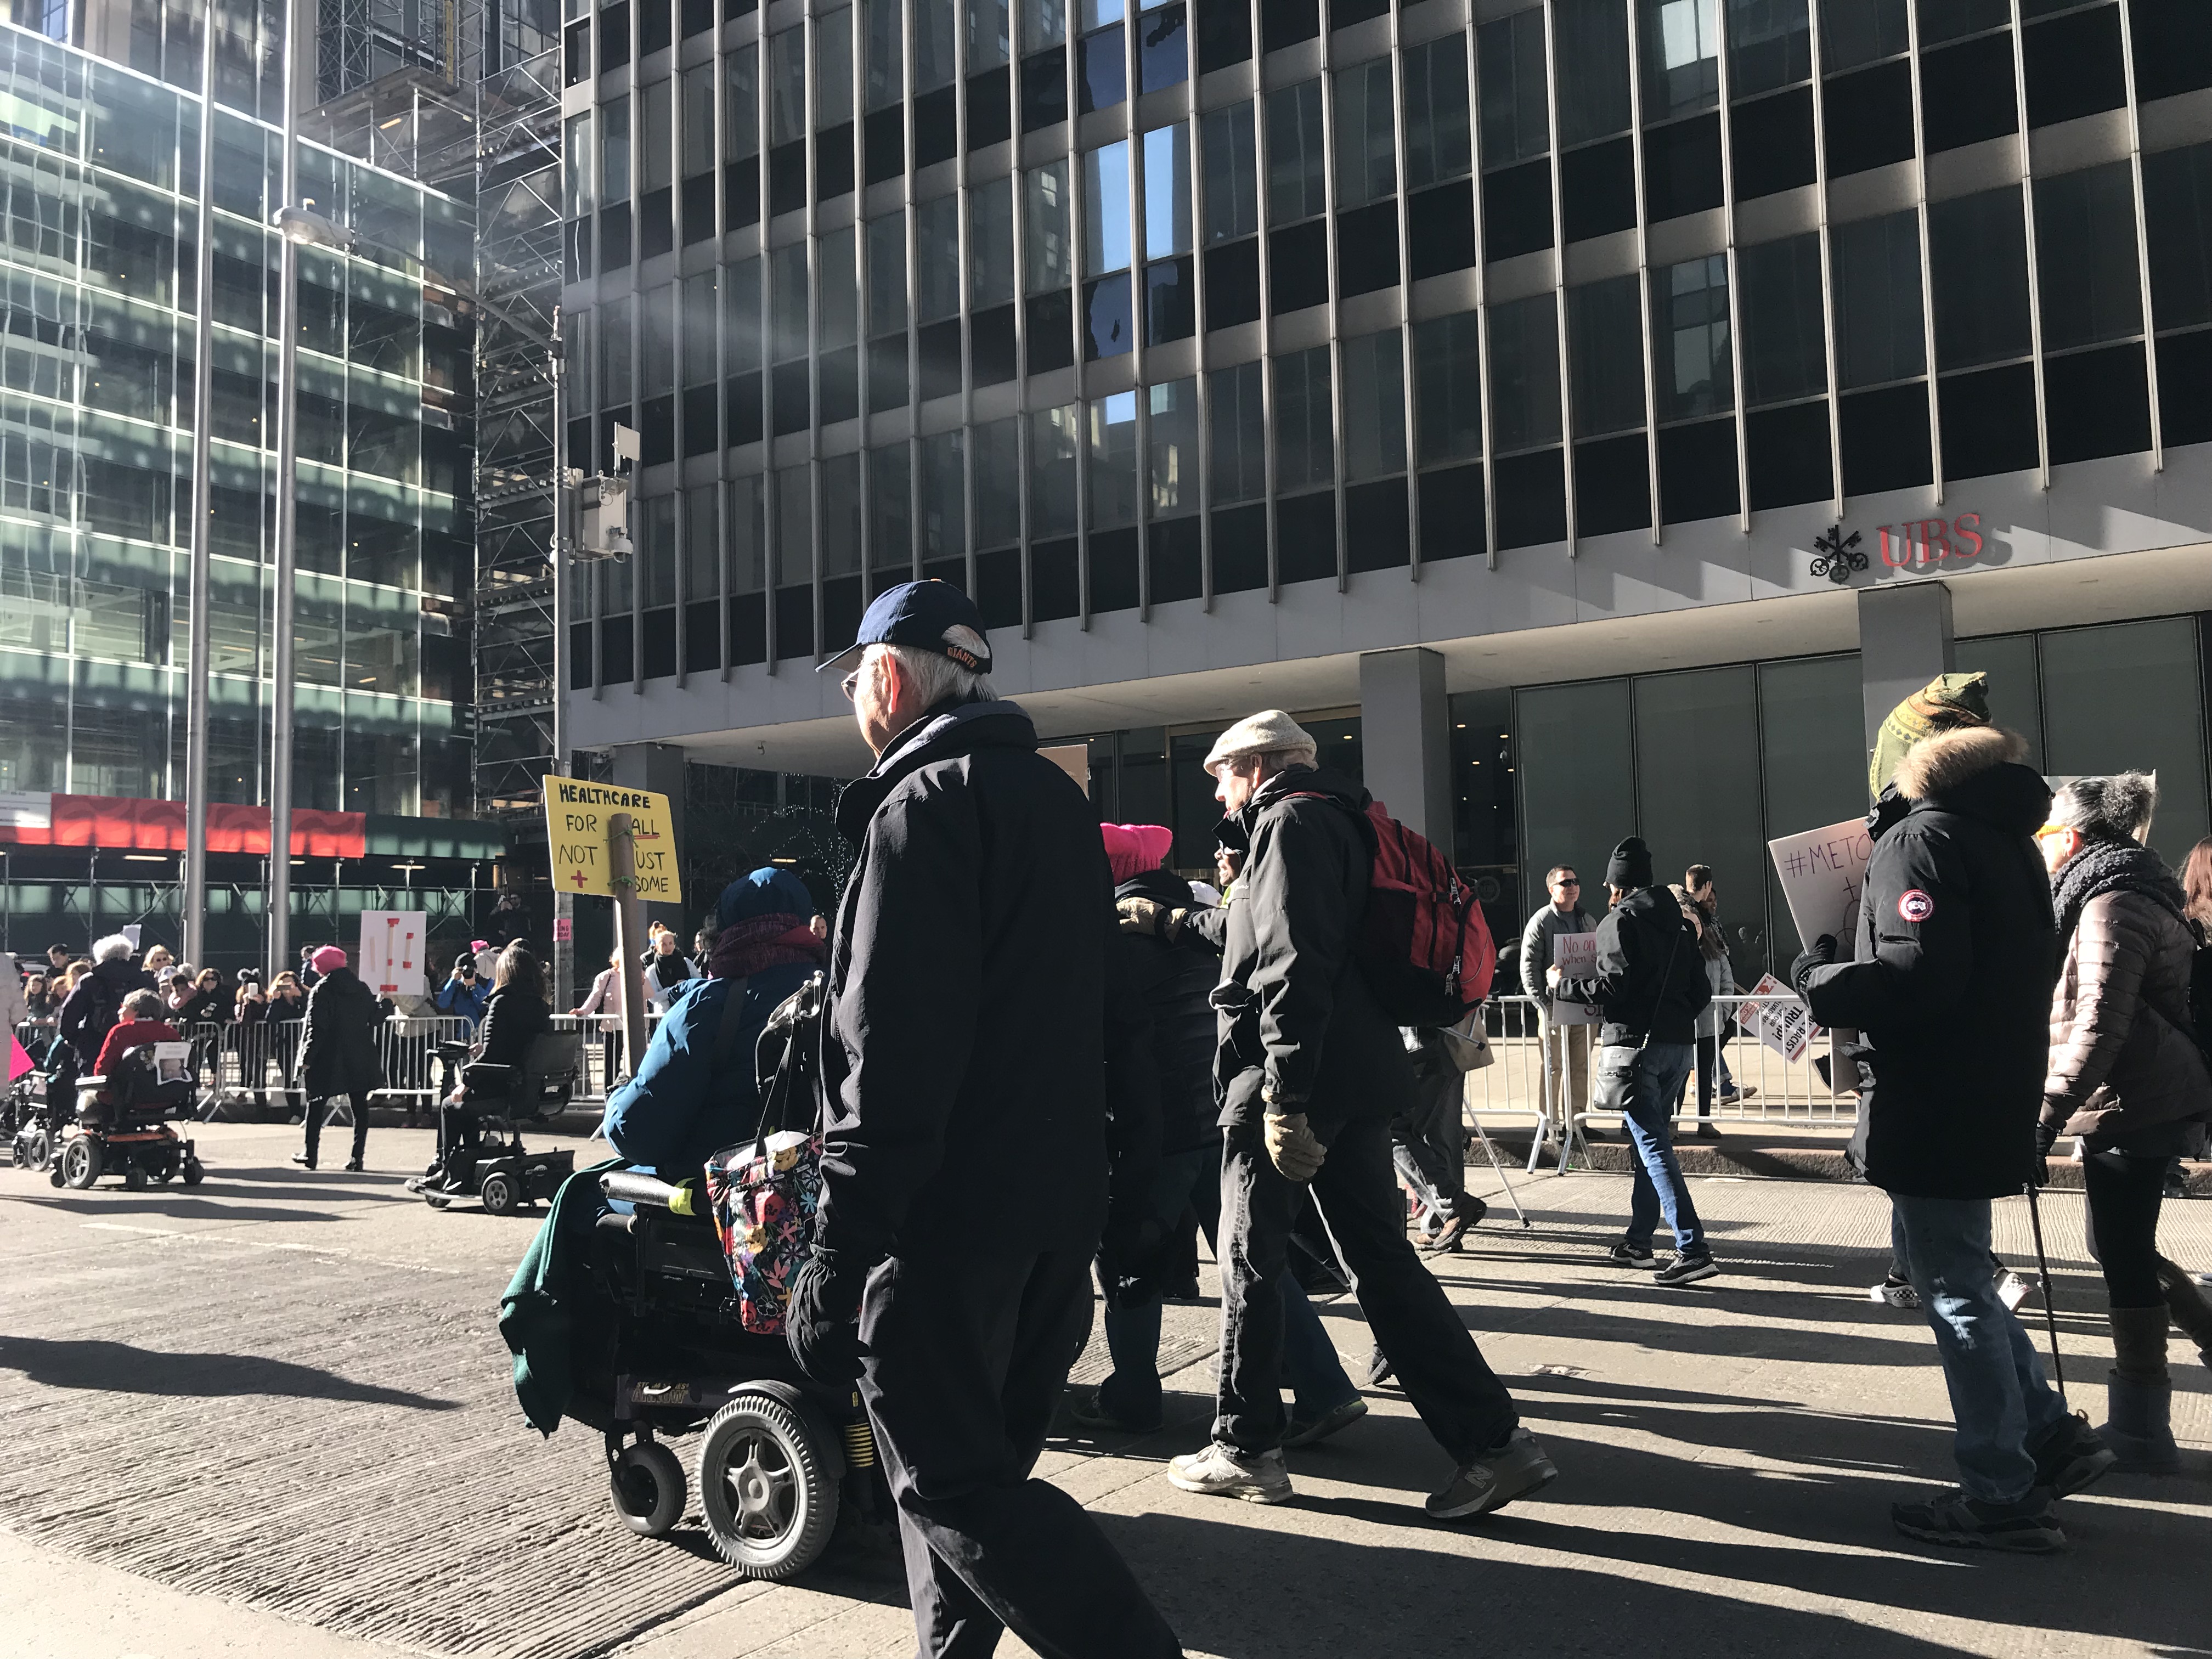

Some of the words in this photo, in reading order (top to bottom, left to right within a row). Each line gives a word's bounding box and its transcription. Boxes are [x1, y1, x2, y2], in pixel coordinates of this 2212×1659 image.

[1876, 513, 1982, 567] UBS
[947, 647, 977, 668] GIANTS
[558, 783, 651, 809] HEALTHCARE
[566, 814, 597, 832] FOR
[632, 818, 659, 835] ALL
[559, 844, 598, 866] NOT
[635, 851, 665, 871] UST
[1784, 833, 1872, 878] #METO
[1563, 936, 1578, 954] No
[1583, 940, 1595, 951] on
[1562, 956, 1586, 966] when
[1786, 1026, 1807, 1053] RACIST
